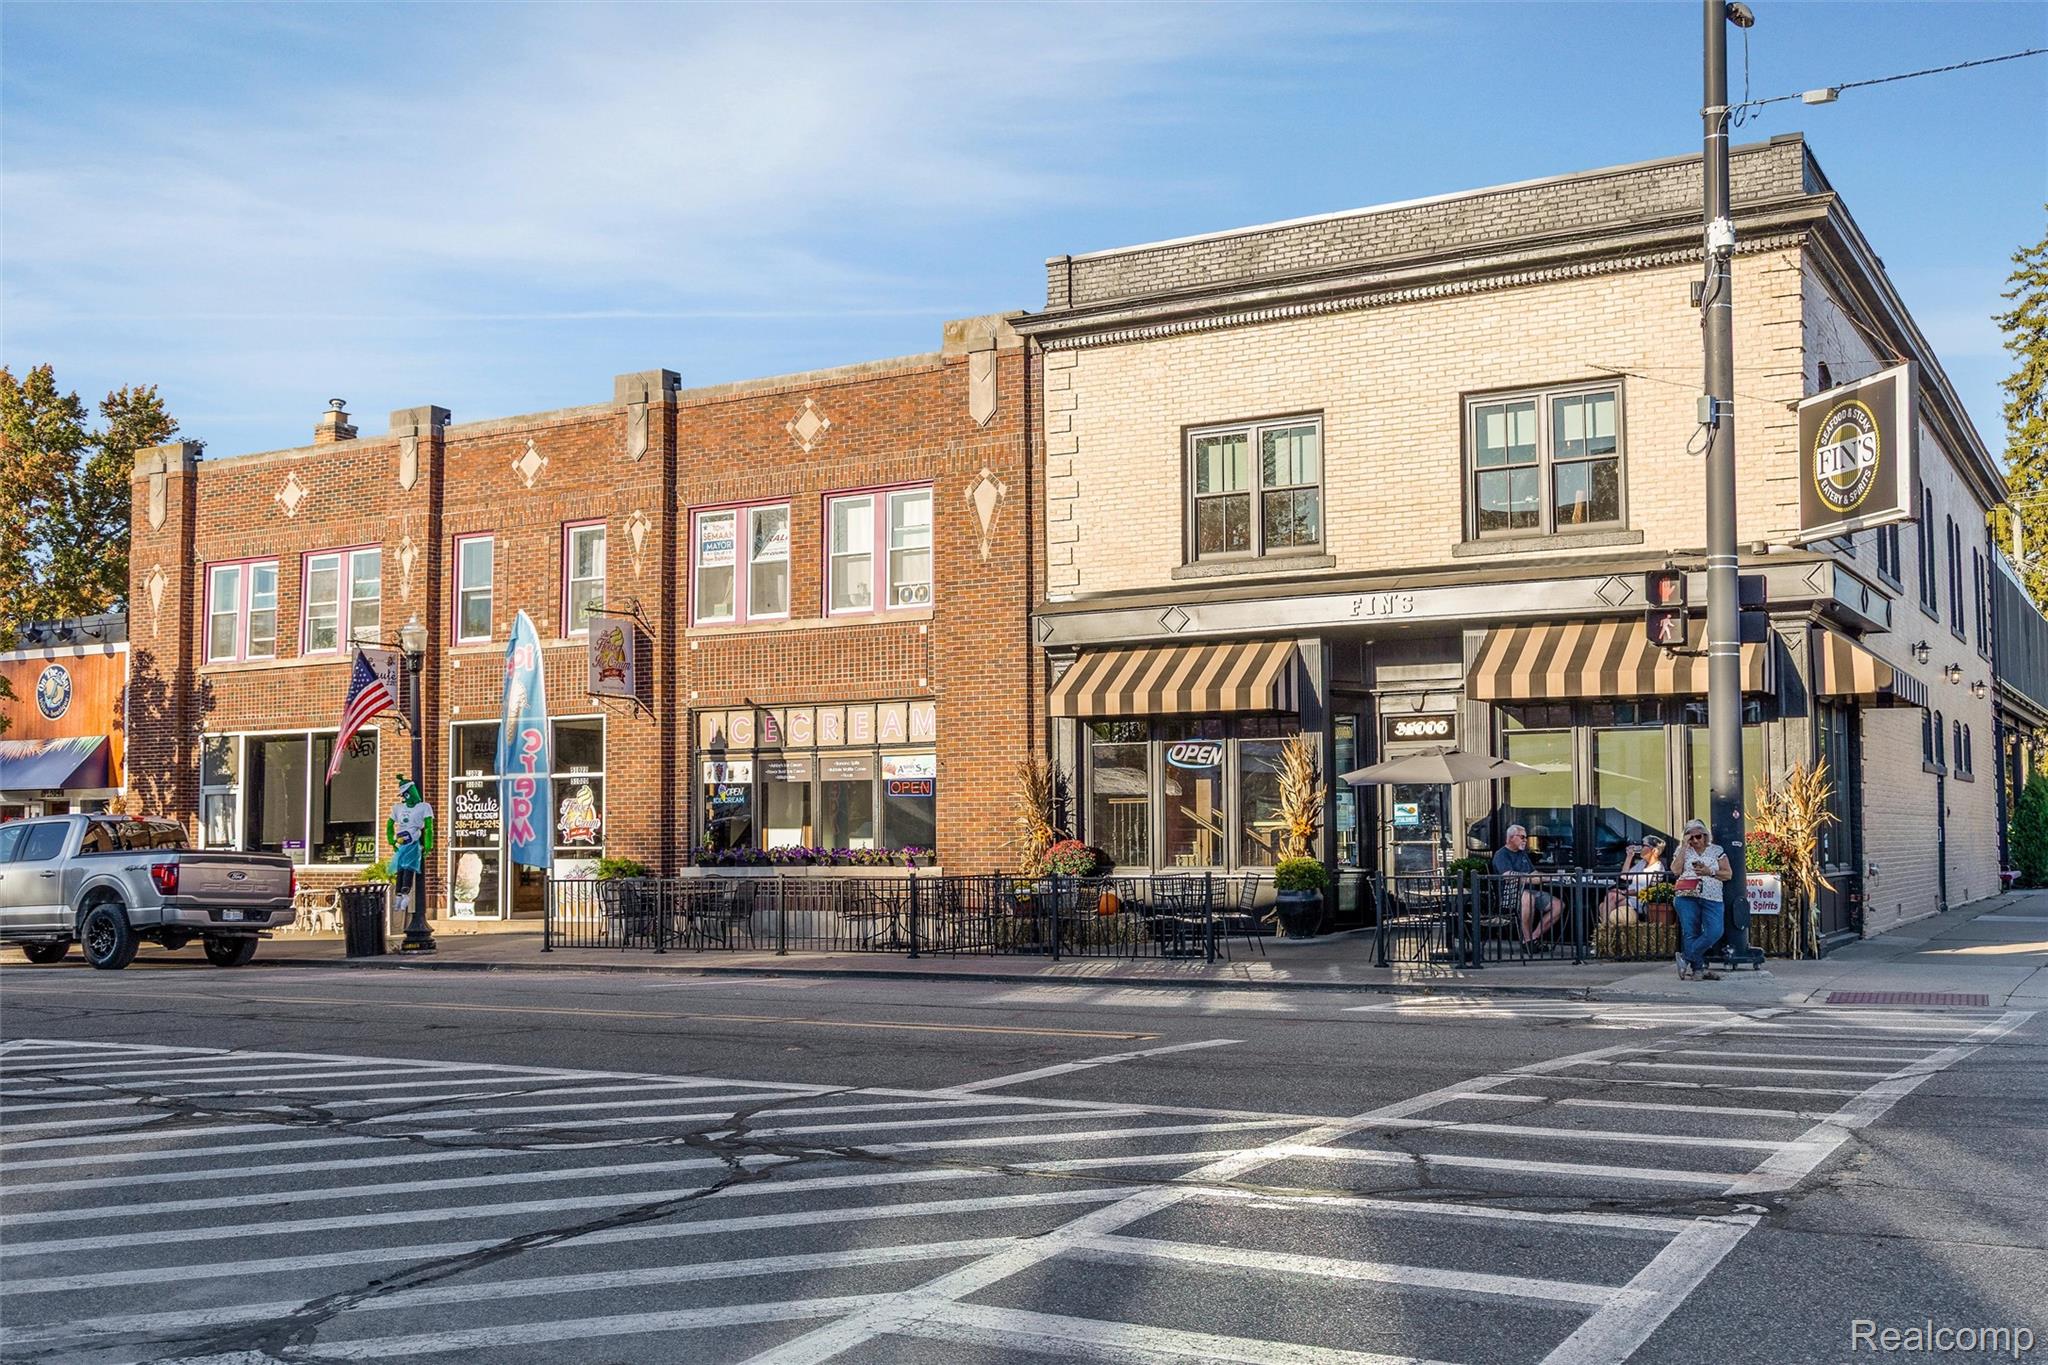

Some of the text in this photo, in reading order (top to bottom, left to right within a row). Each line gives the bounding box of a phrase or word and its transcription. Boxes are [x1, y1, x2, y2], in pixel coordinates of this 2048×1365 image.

[1820, 410, 1847, 445] SEAFOOD
[1853, 409, 1871, 432] STEAK
[1819, 436, 1874, 476] FIN'S
[1820, 479, 1844, 505] EATERY
[1850, 469, 1872, 502] SPIRITS
[706, 541, 732, 550] MAYOR
[1349, 594, 1414, 617] FIN'S
[1171, 744, 1222, 765] OPEN
[891, 782, 930, 793] OPEN
[467, 789, 480, 802] Le
[355, 842, 375, 853] BAD
[1758, 889, 1774, 899] Year
[1753, 900, 1778, 912] Spirits
